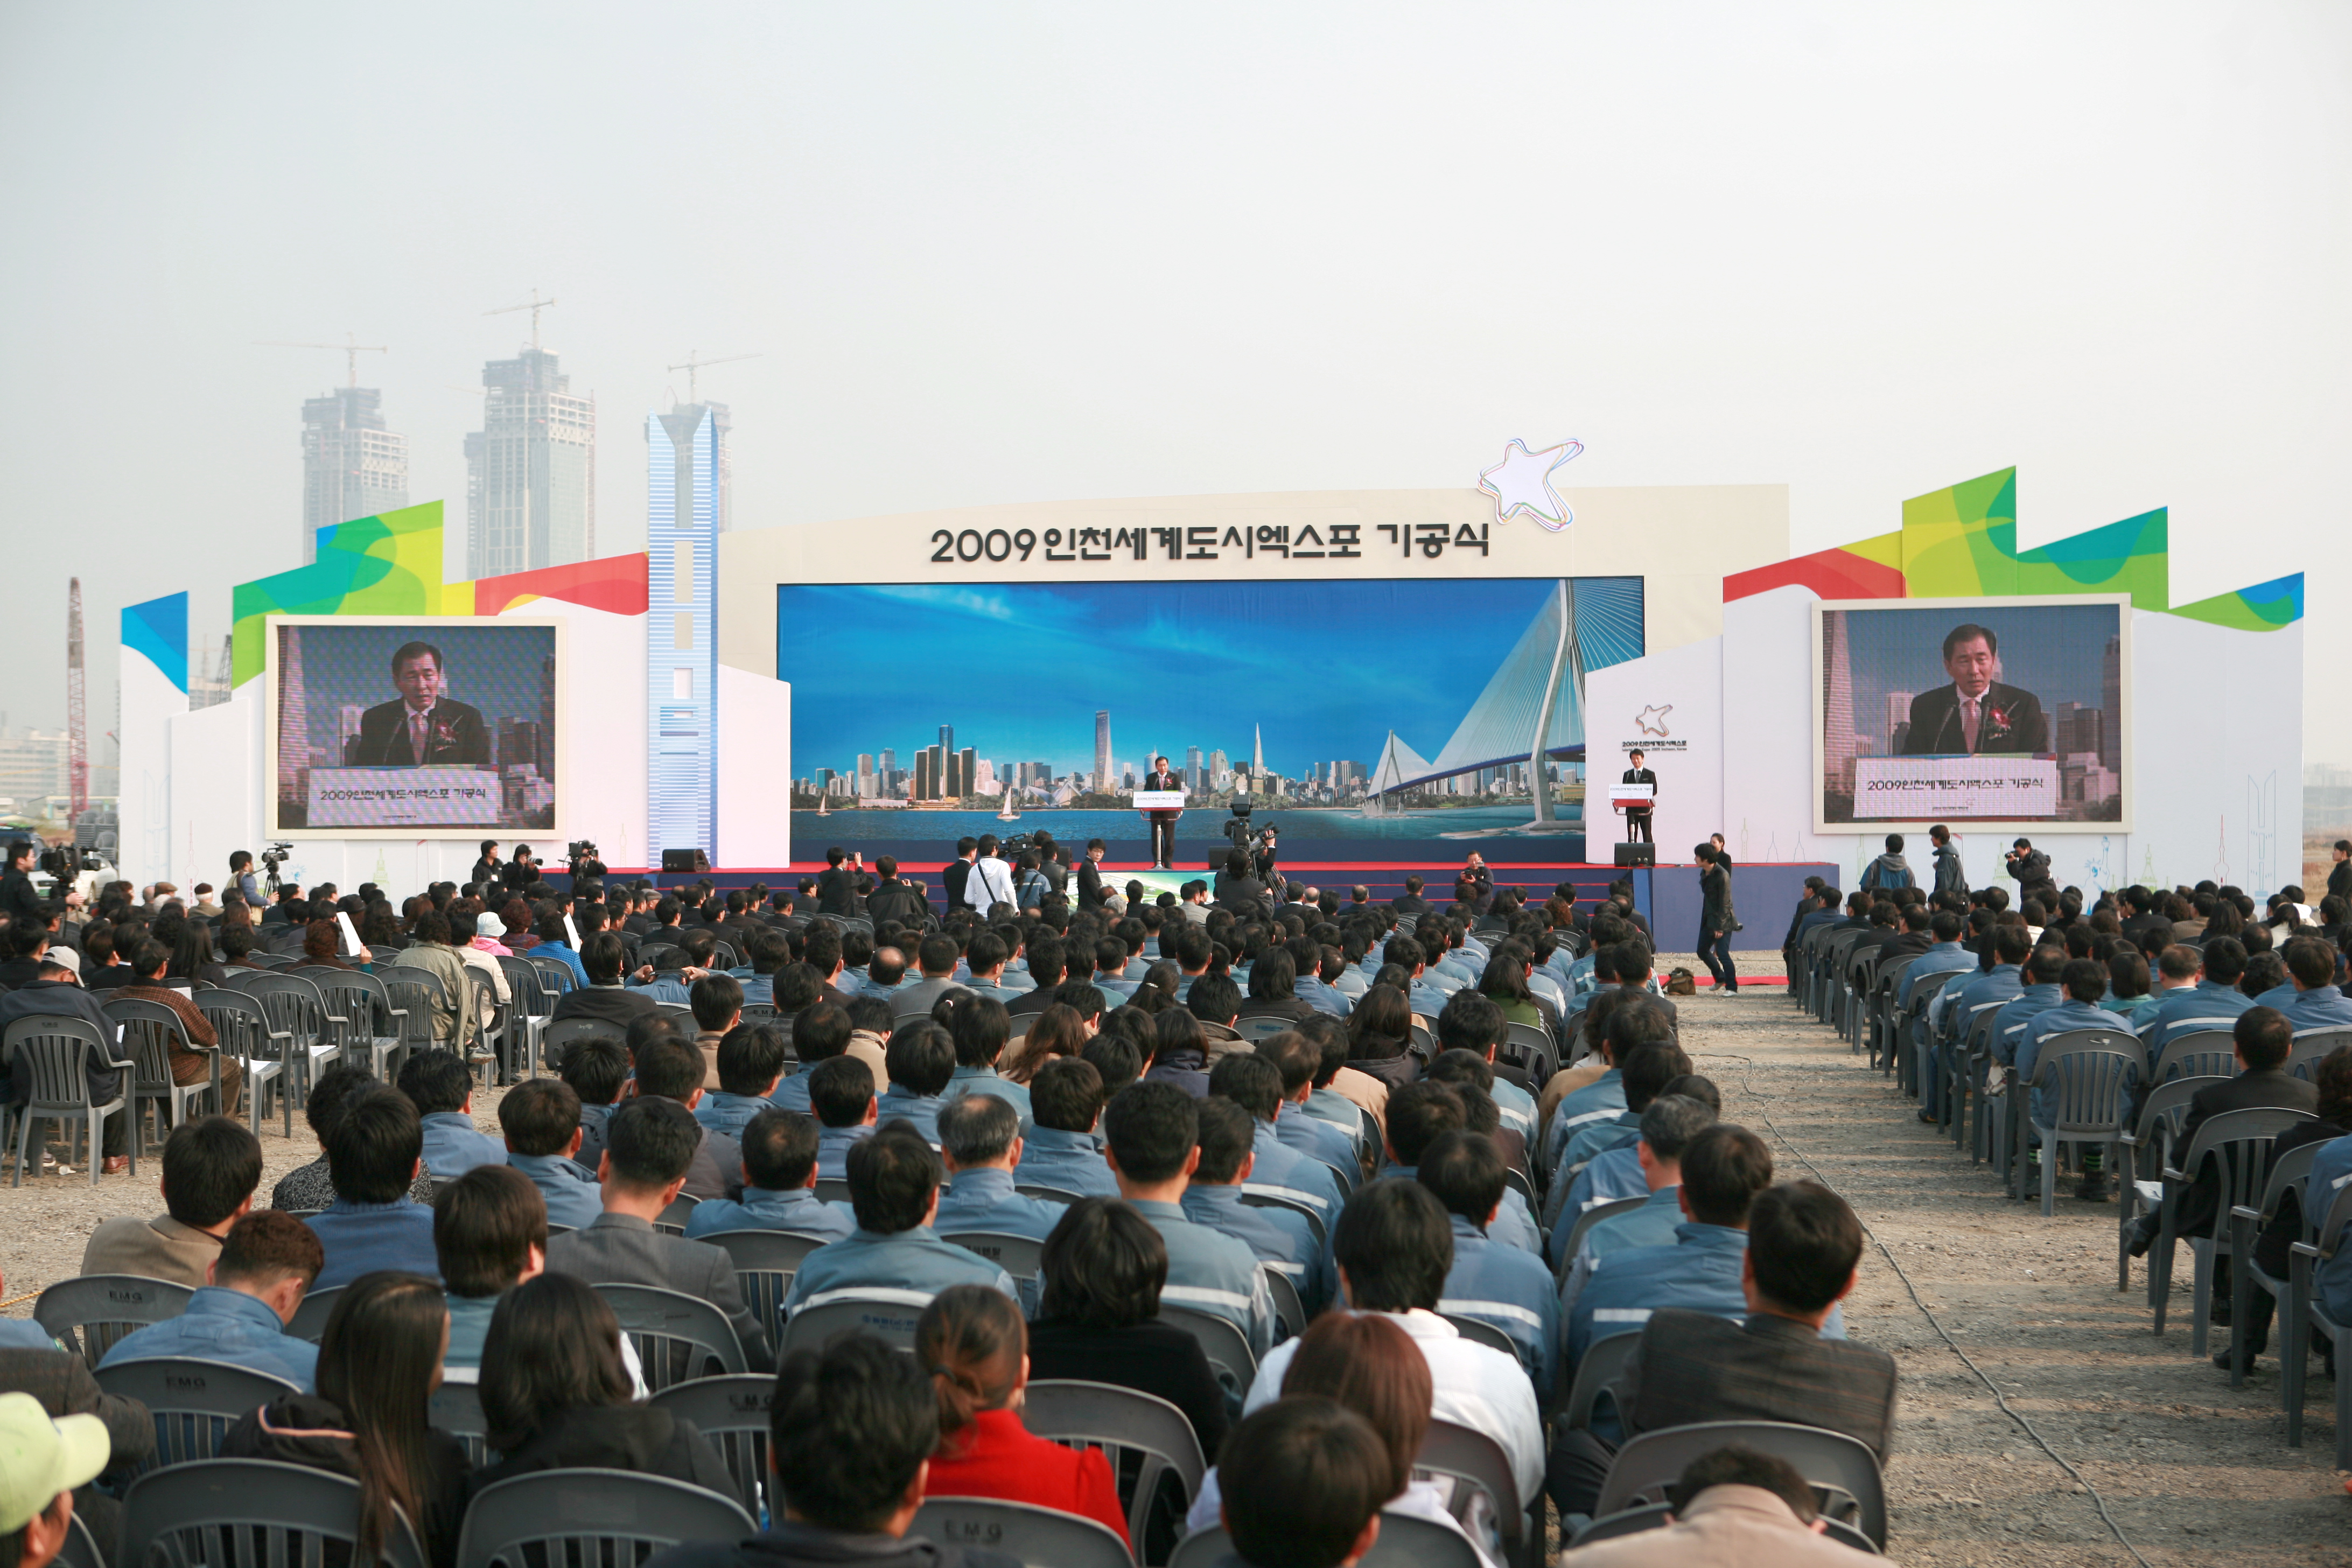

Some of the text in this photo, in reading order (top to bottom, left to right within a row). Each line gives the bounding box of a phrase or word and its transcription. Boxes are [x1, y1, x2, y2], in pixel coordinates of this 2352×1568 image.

[930, 523, 1489, 562] 2009인천세계도시엑스포 기공식
[2008, 778, 2042, 789] 기공식
